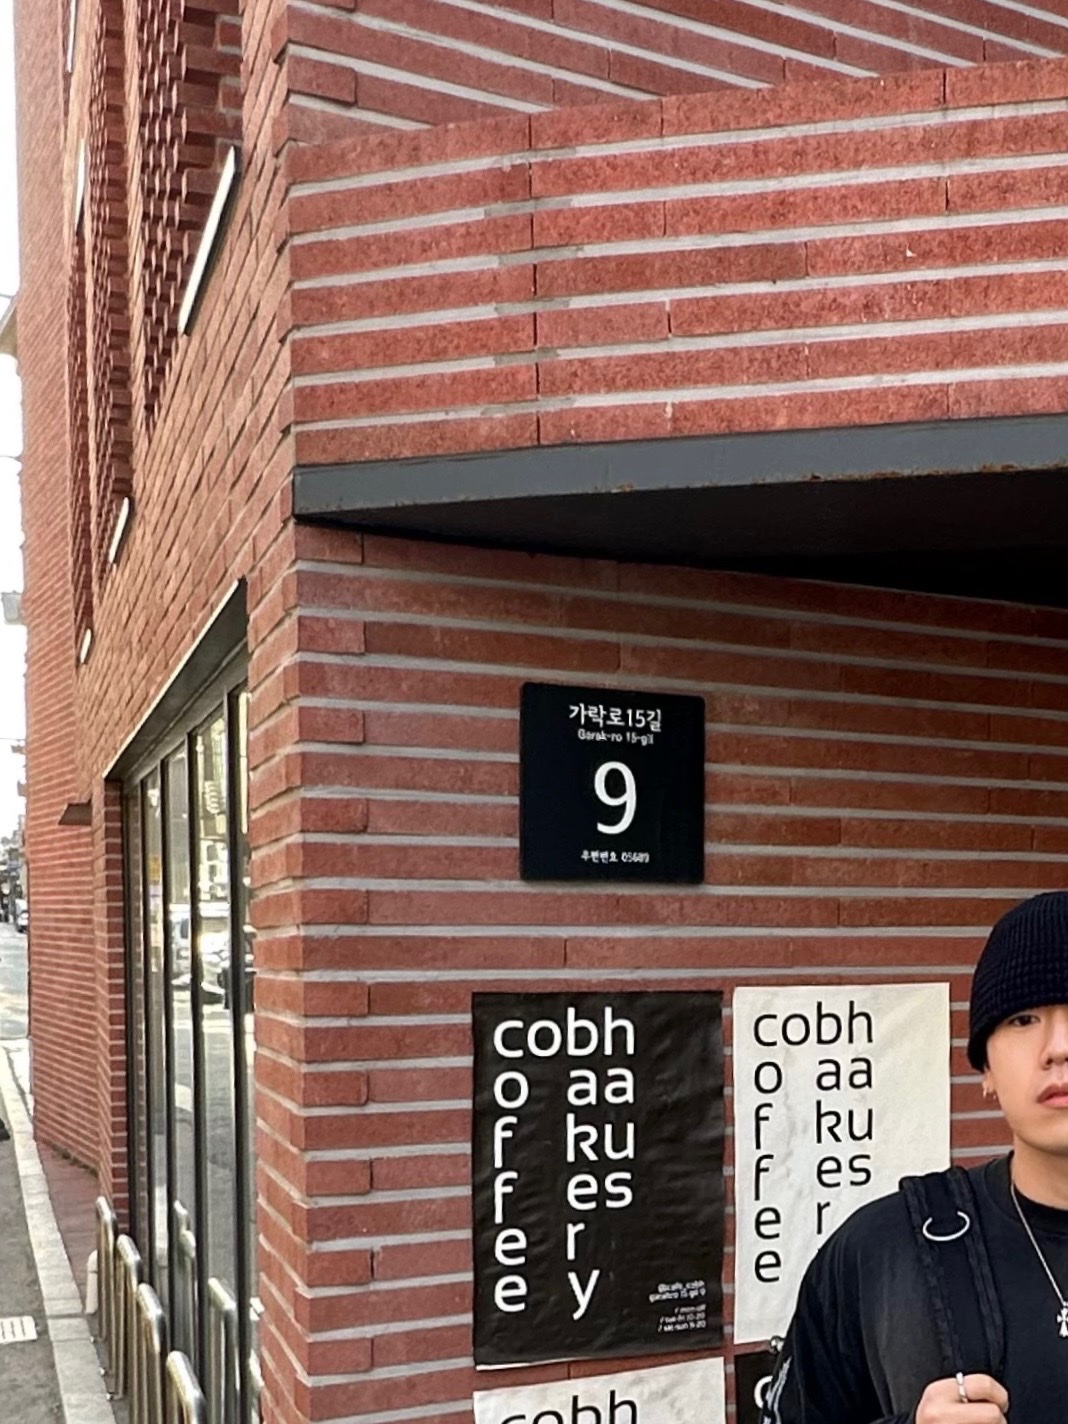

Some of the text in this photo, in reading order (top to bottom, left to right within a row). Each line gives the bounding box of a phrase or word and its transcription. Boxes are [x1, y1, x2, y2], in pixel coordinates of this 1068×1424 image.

[569, 703, 662, 732] 가락로15길
[578, 729, 654, 746] Garak-ro 15-gil
[594, 761, 637, 835] 9
[493, 1007, 636, 1059] cobh
[754, 1000, 874, 1047] cobh
